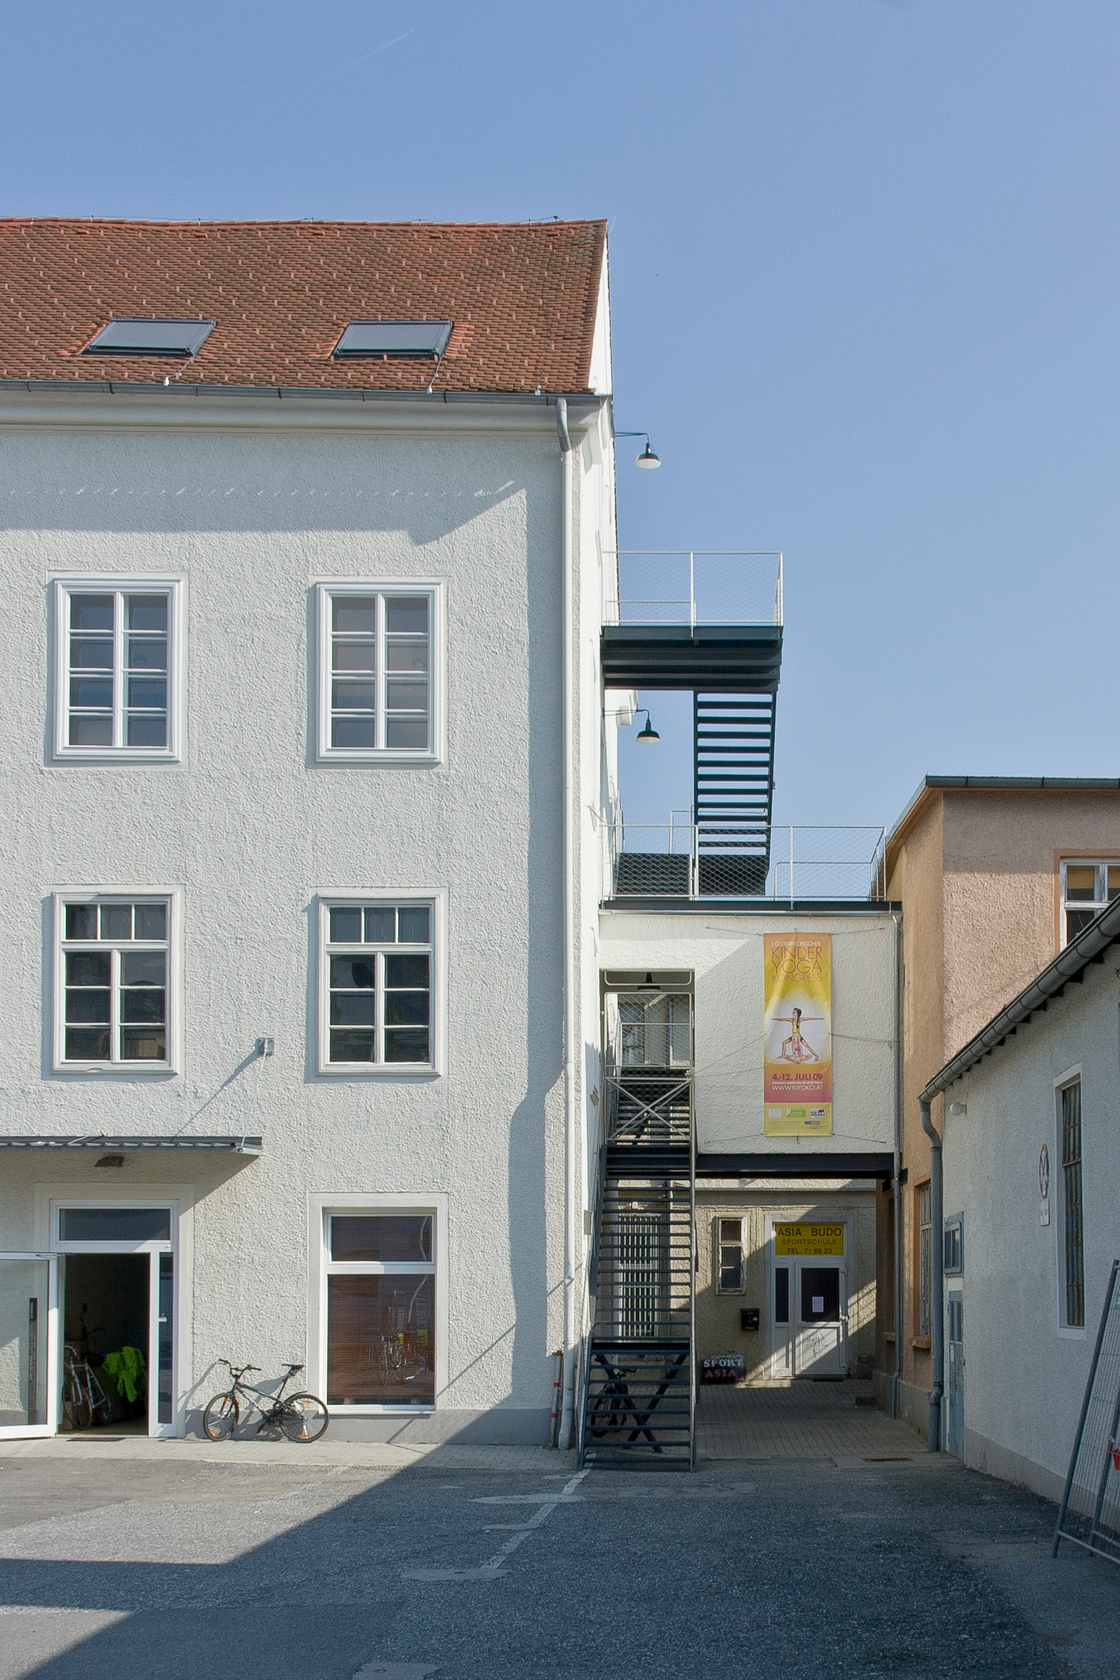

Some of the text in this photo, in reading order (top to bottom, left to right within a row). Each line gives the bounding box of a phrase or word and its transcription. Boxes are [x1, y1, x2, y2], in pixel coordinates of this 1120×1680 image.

[772, 946, 822, 959] KINDER
[772, 959, 822, 973] YOGA
[772, 974, 822, 982] KONGRESS
[778, 1228, 842, 1236] ASIA BUDO
[704, 1359, 743, 1367] SPORT
[705, 1369, 737, 1378] ASIA
